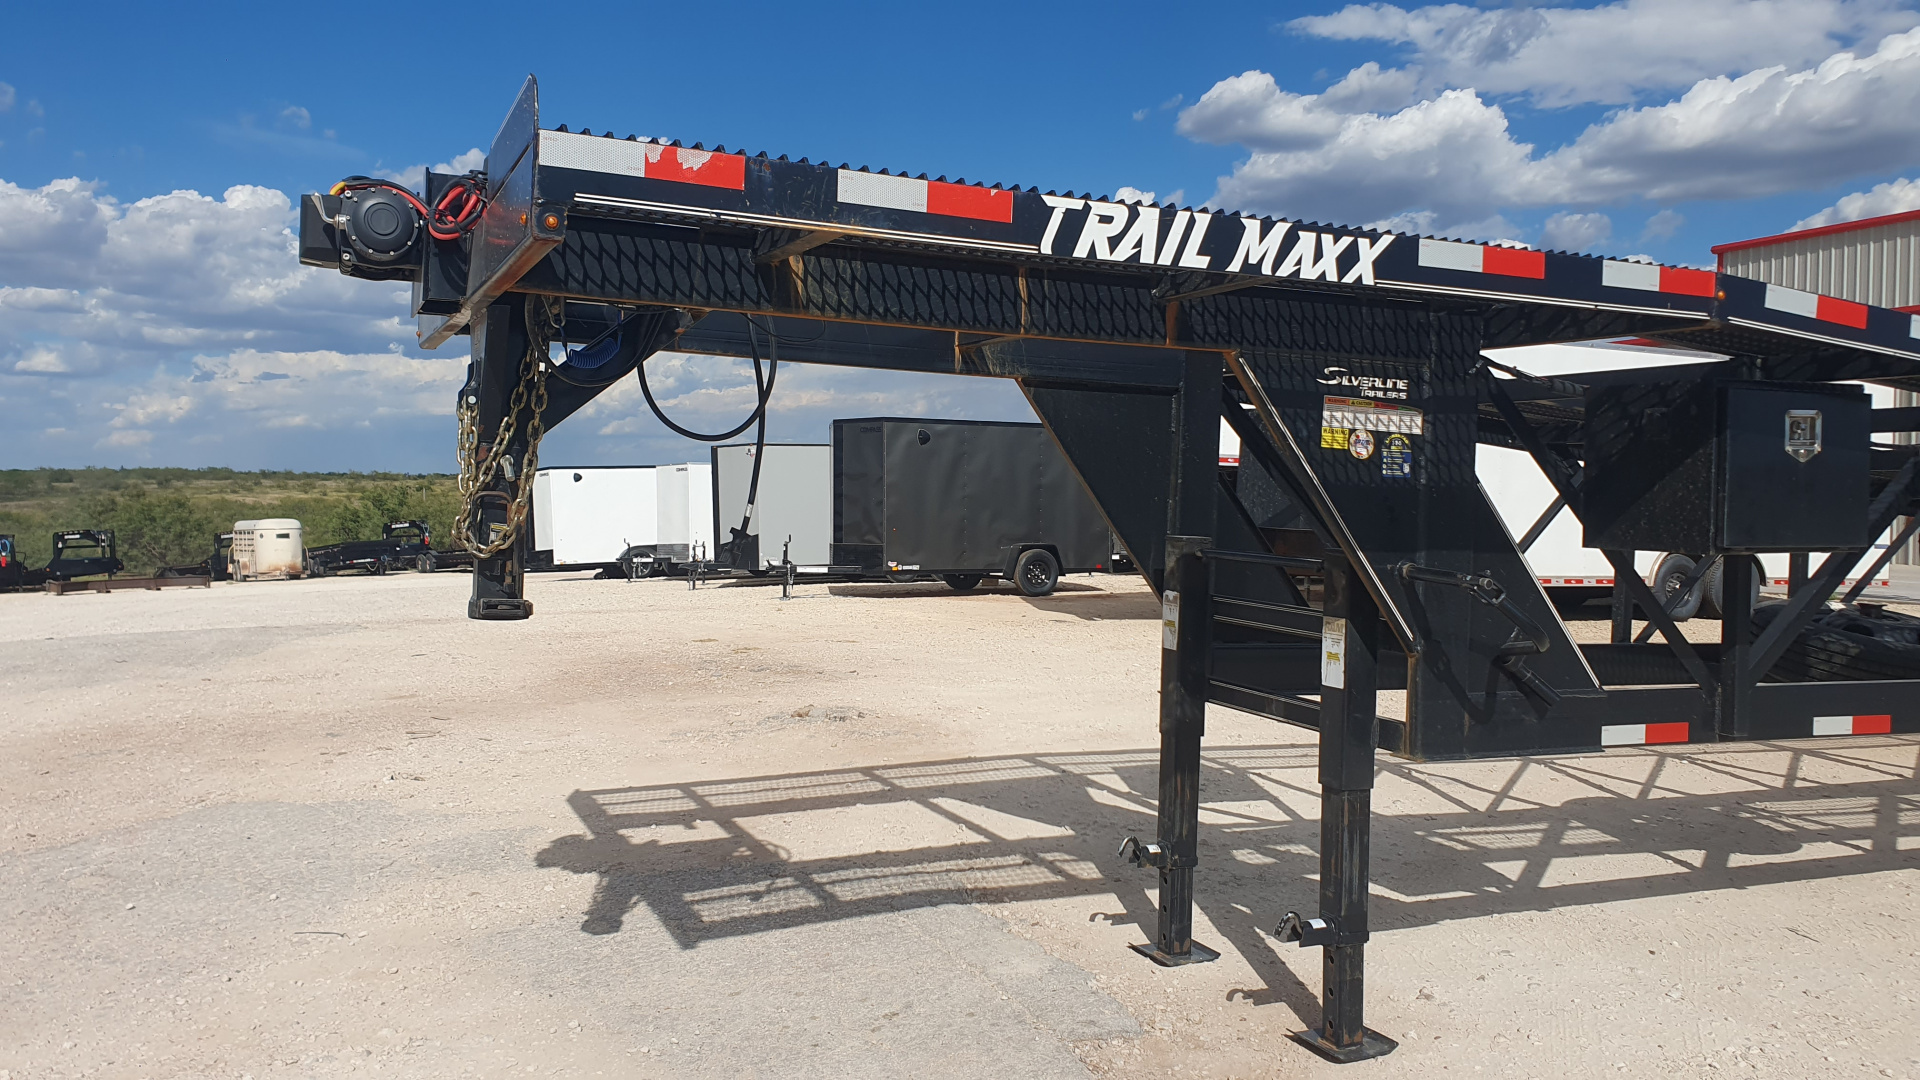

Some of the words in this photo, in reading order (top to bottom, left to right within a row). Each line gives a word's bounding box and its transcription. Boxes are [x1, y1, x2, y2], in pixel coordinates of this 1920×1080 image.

[1040, 194, 1212, 269] TRAIL
[1225, 217, 1396, 285] MAXX
[1316, 367, 1409, 389] SILVERLINE
[1360, 387, 1407, 399] TRAILERS
